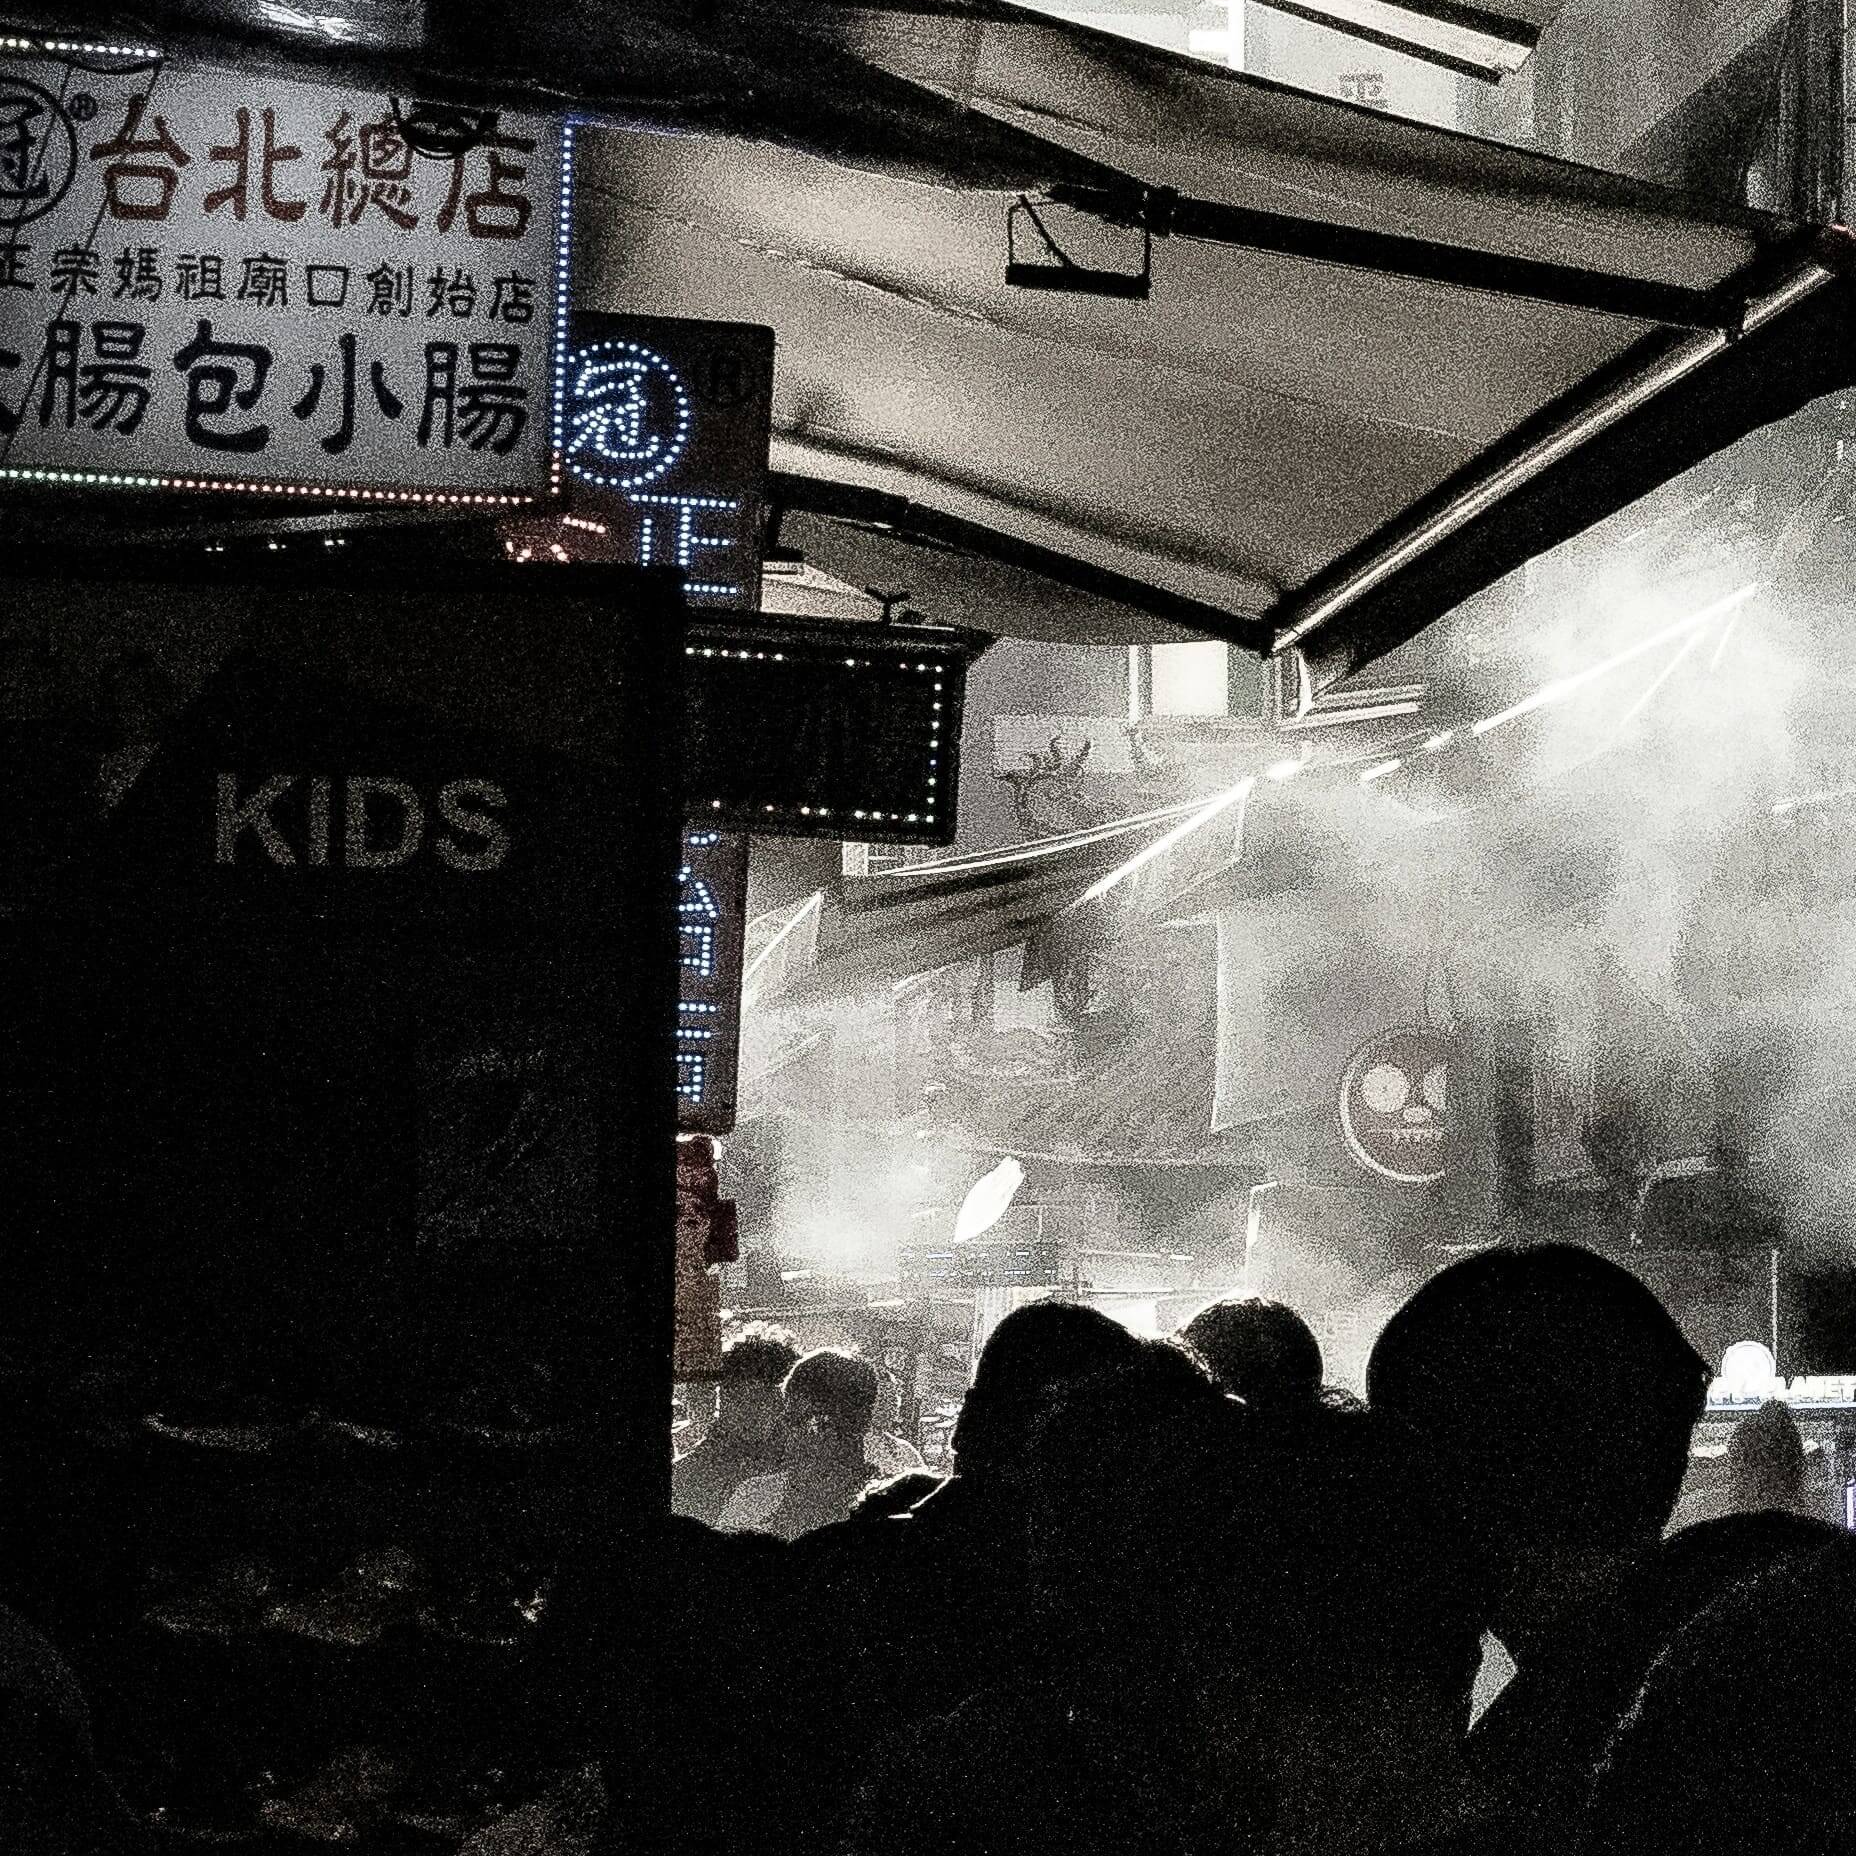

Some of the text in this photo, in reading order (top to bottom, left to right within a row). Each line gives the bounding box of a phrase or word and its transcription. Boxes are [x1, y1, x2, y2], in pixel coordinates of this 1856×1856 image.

[90, 94, 538, 240] 台北總店
[0, 242, 537, 325] 正宗媽祖廟口創始店
[0, 318, 531, 456] 腸包小腸
[211, 772, 513, 875] KIDS
